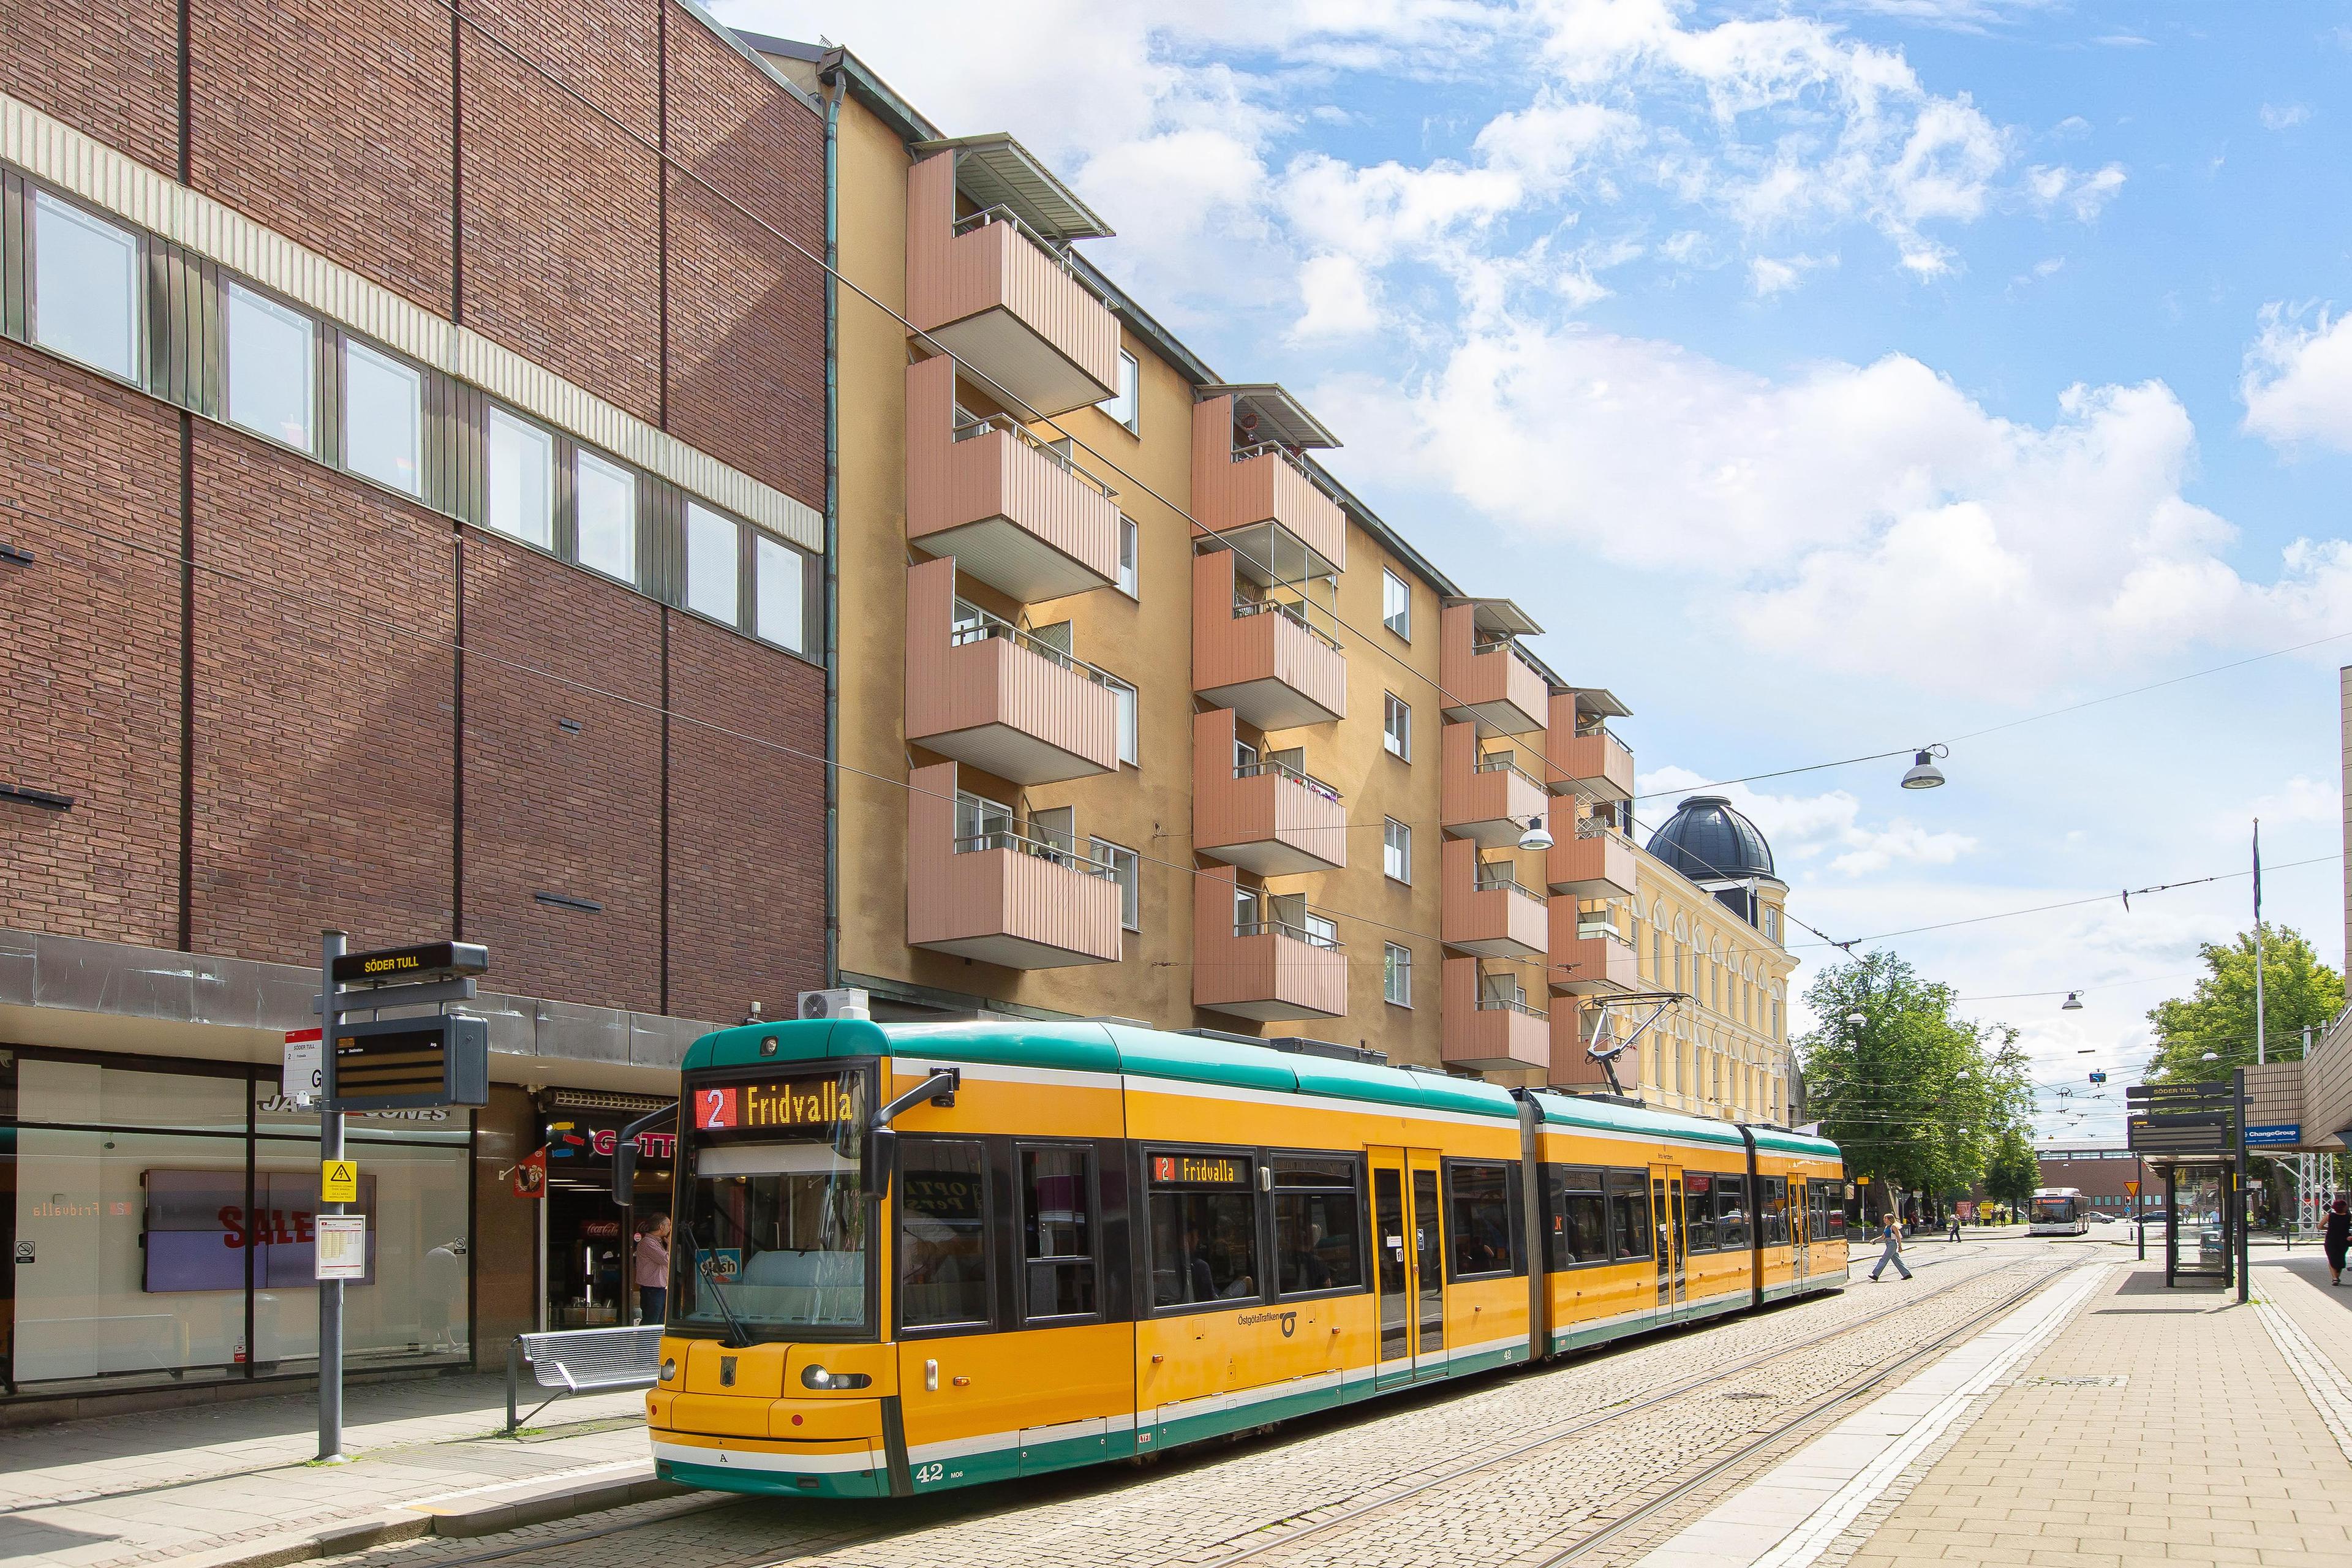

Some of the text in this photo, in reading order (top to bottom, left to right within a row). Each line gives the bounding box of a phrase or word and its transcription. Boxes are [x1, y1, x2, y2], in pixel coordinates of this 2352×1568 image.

[364, 956, 419, 973] SÖDER TULL
[312, 1069, 322, 1088] G
[707, 1081, 853, 1128] 2 Fridvalla
[592, 1129, 677, 1158] GTT
[1161, 1158, 1234, 1182] 2 Fridvalla
[218, 1205, 315, 1248] SALE
[1238, 1312, 1280, 1326] ÖstgötaTrafiken
[1504, 1349, 1512, 1360] 42
[720, 1453, 728, 1463] A
[916, 1463, 943, 1483] 42
